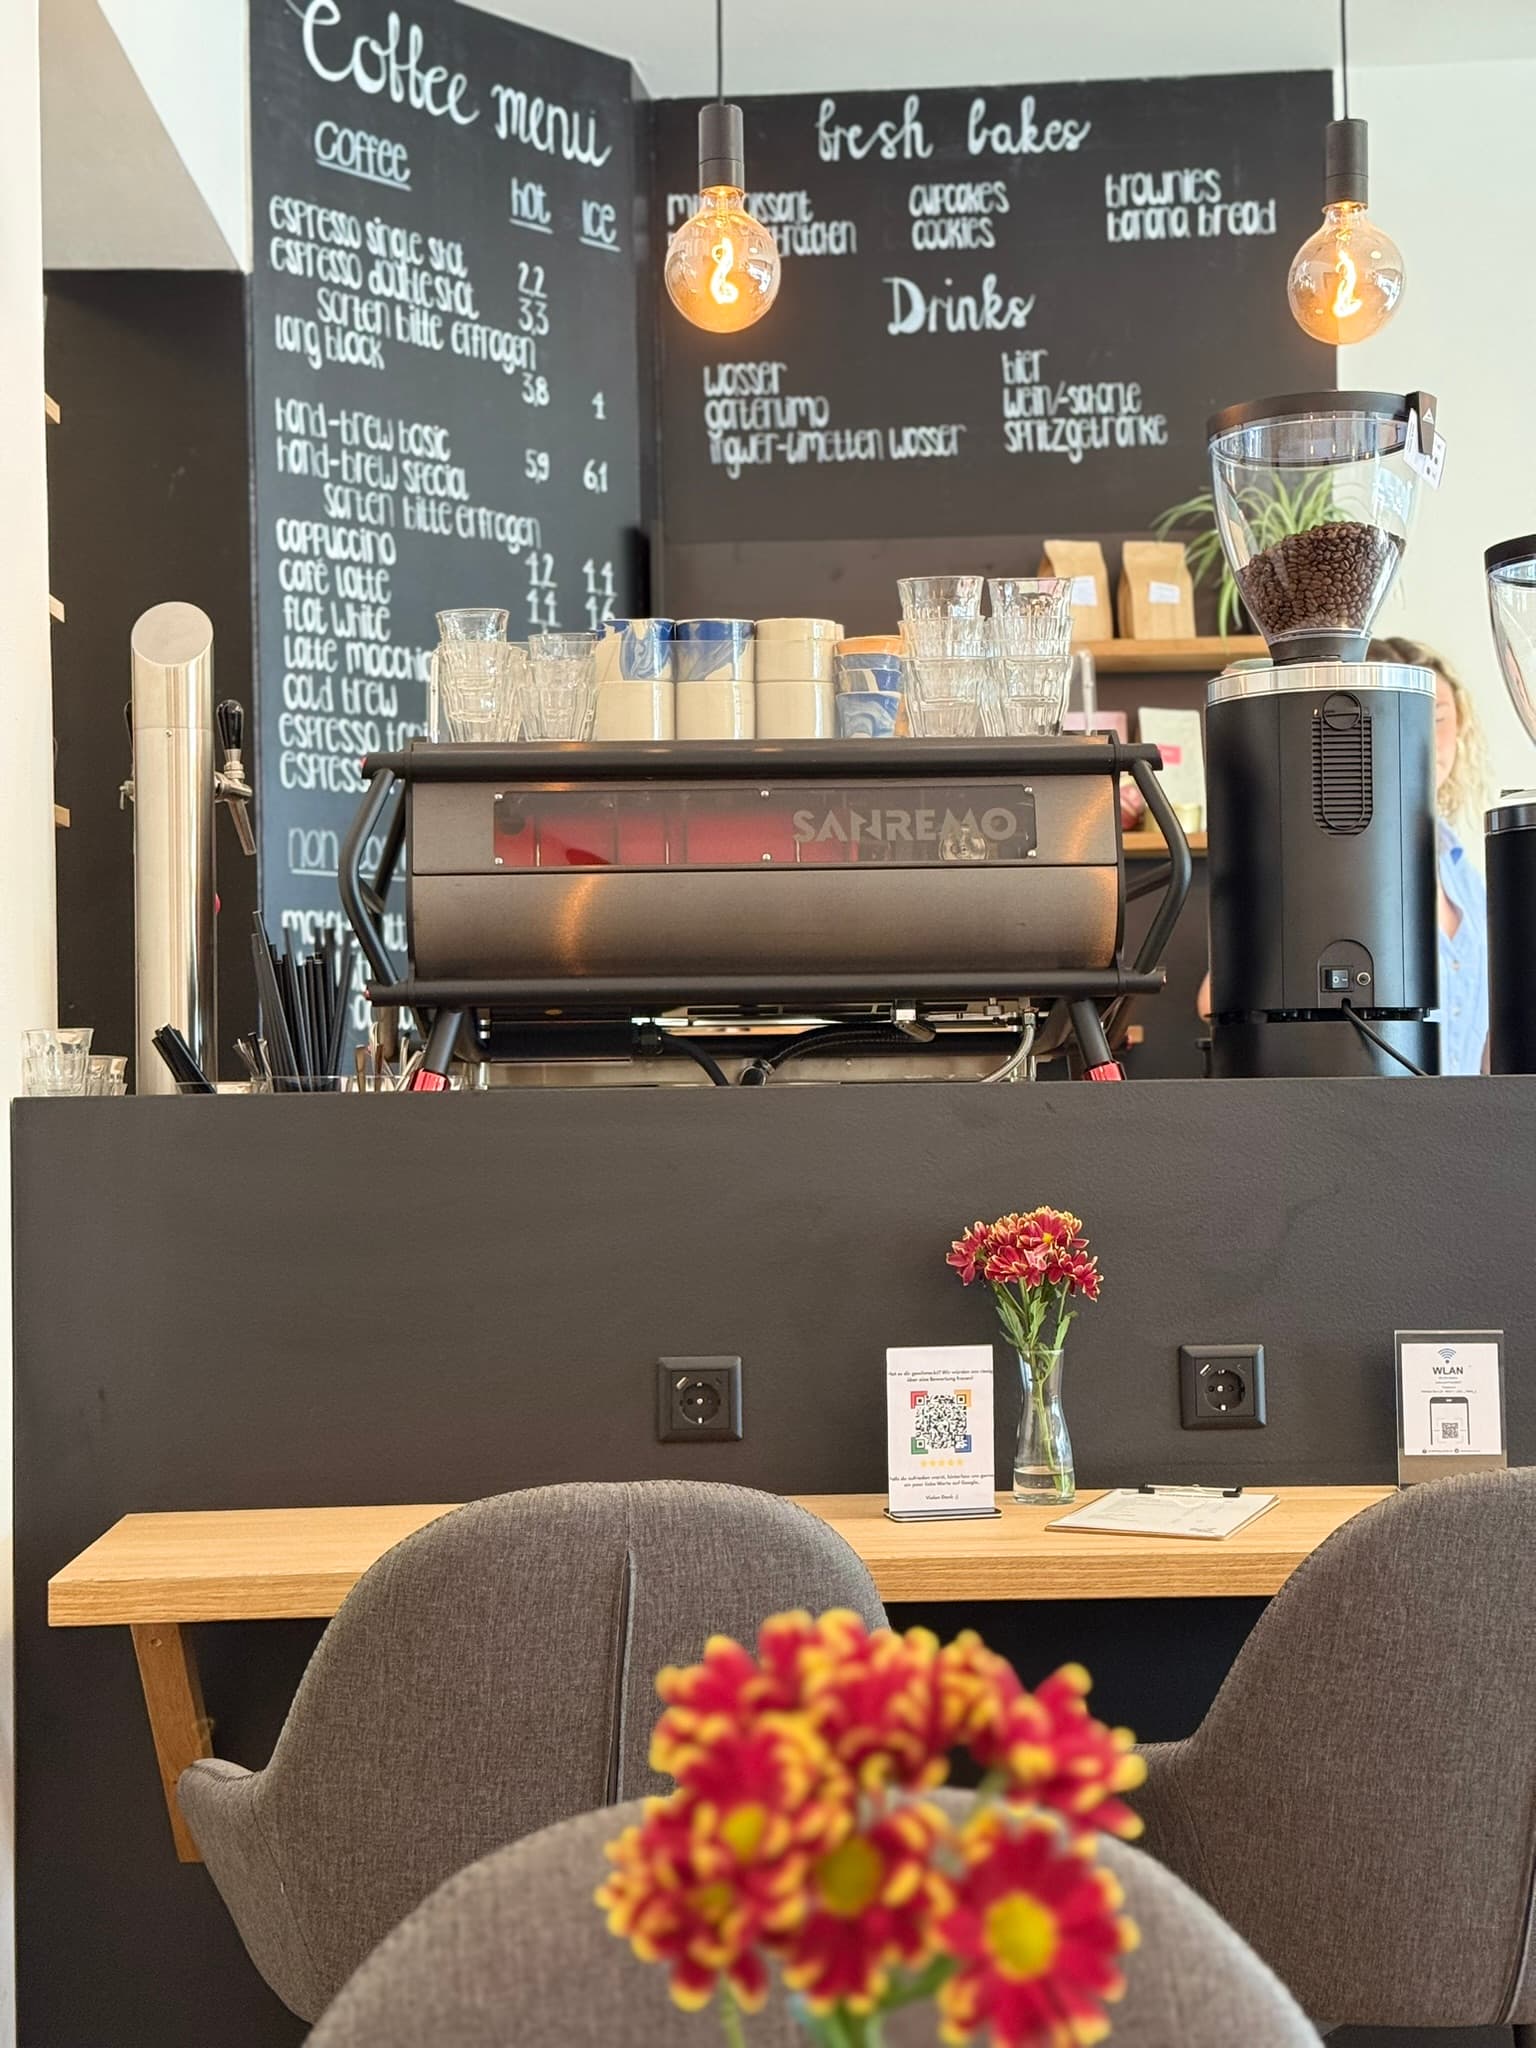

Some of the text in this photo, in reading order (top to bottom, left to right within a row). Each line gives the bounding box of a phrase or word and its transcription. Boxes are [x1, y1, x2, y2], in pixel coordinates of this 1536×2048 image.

[296, 0, 612, 167] Coffee menu
[815, 95, 1091, 162] fresh bakes
[511, 177, 552, 224] hot
[581, 199, 617, 244] ice
[909, 180, 1010, 217] cupcakes
[1105, 168, 1222, 208] brownies
[269, 195, 468, 278] espresso single shot
[911, 216, 996, 250] cookies
[1107, 198, 1276, 242] banana bread
[270, 236, 480, 320] espresso double shot
[882, 272, 1036, 336] Drinks
[275, 313, 385, 371] long black
[317, 287, 536, 375] sorten bitte erfragen
[703, 361, 787, 397] wasser
[1001, 349, 1048, 385] bier
[275, 396, 452, 462] hand-brew basic
[888, 423, 967, 460] wasser
[276, 435, 470, 501] hand-brew special
[323, 482, 543, 555] sorten bitte erfragen
[275, 517, 397, 566] cappuccino
[334, 563, 393, 604] latte
[283, 594, 392, 640] flat white
[283, 634, 338, 673] latte
[282, 672, 398, 719] cold brew
[278, 712, 381, 757] espresso
[279, 750, 372, 794] espress
[793, 807, 1018, 842] SANREMO
[288, 827, 339, 870] non
[1432, 1366, 1464, 1376] WLAN
